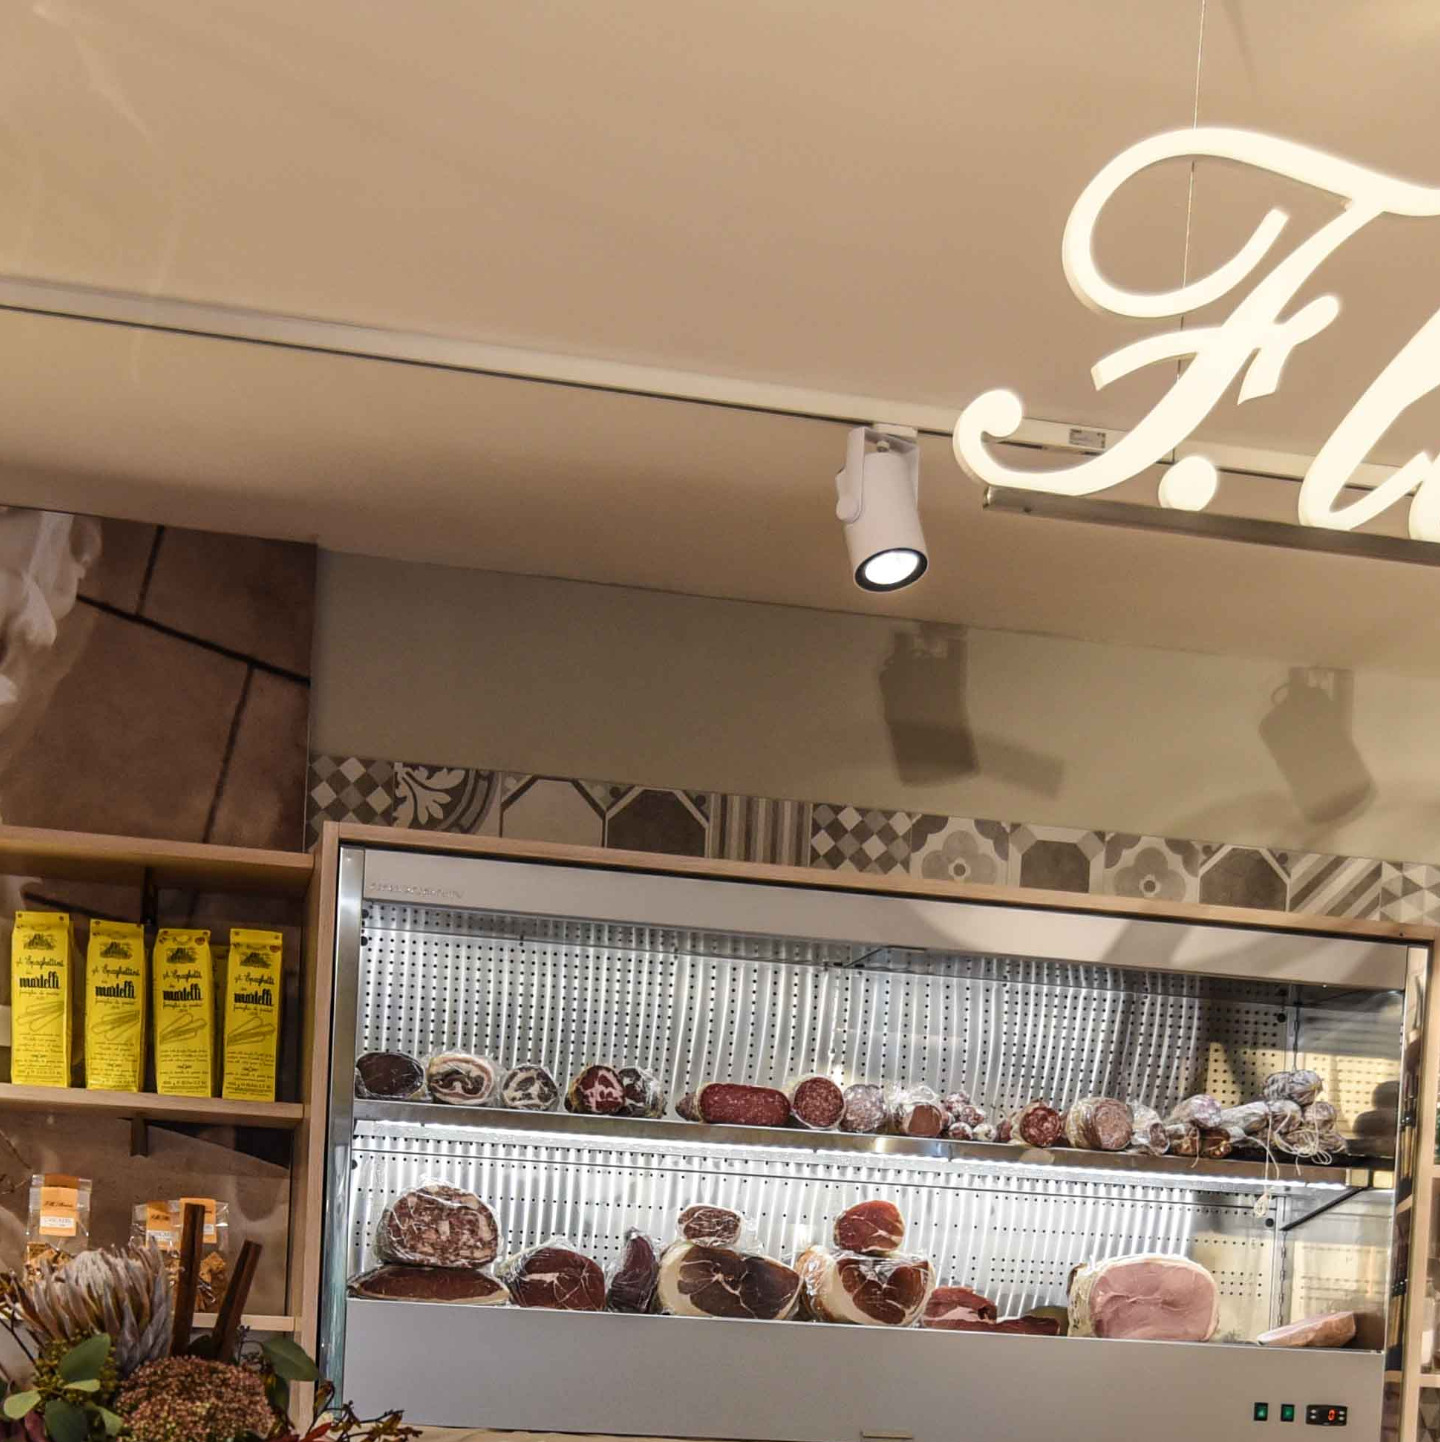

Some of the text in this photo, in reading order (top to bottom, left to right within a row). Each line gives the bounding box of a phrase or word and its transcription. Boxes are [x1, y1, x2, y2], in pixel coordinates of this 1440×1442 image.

[18, 971, 60, 989] martelli
[94, 980, 136, 999] martelli
[162, 982, 203, 1001] martelli
[233, 988, 274, 1007] martelli
